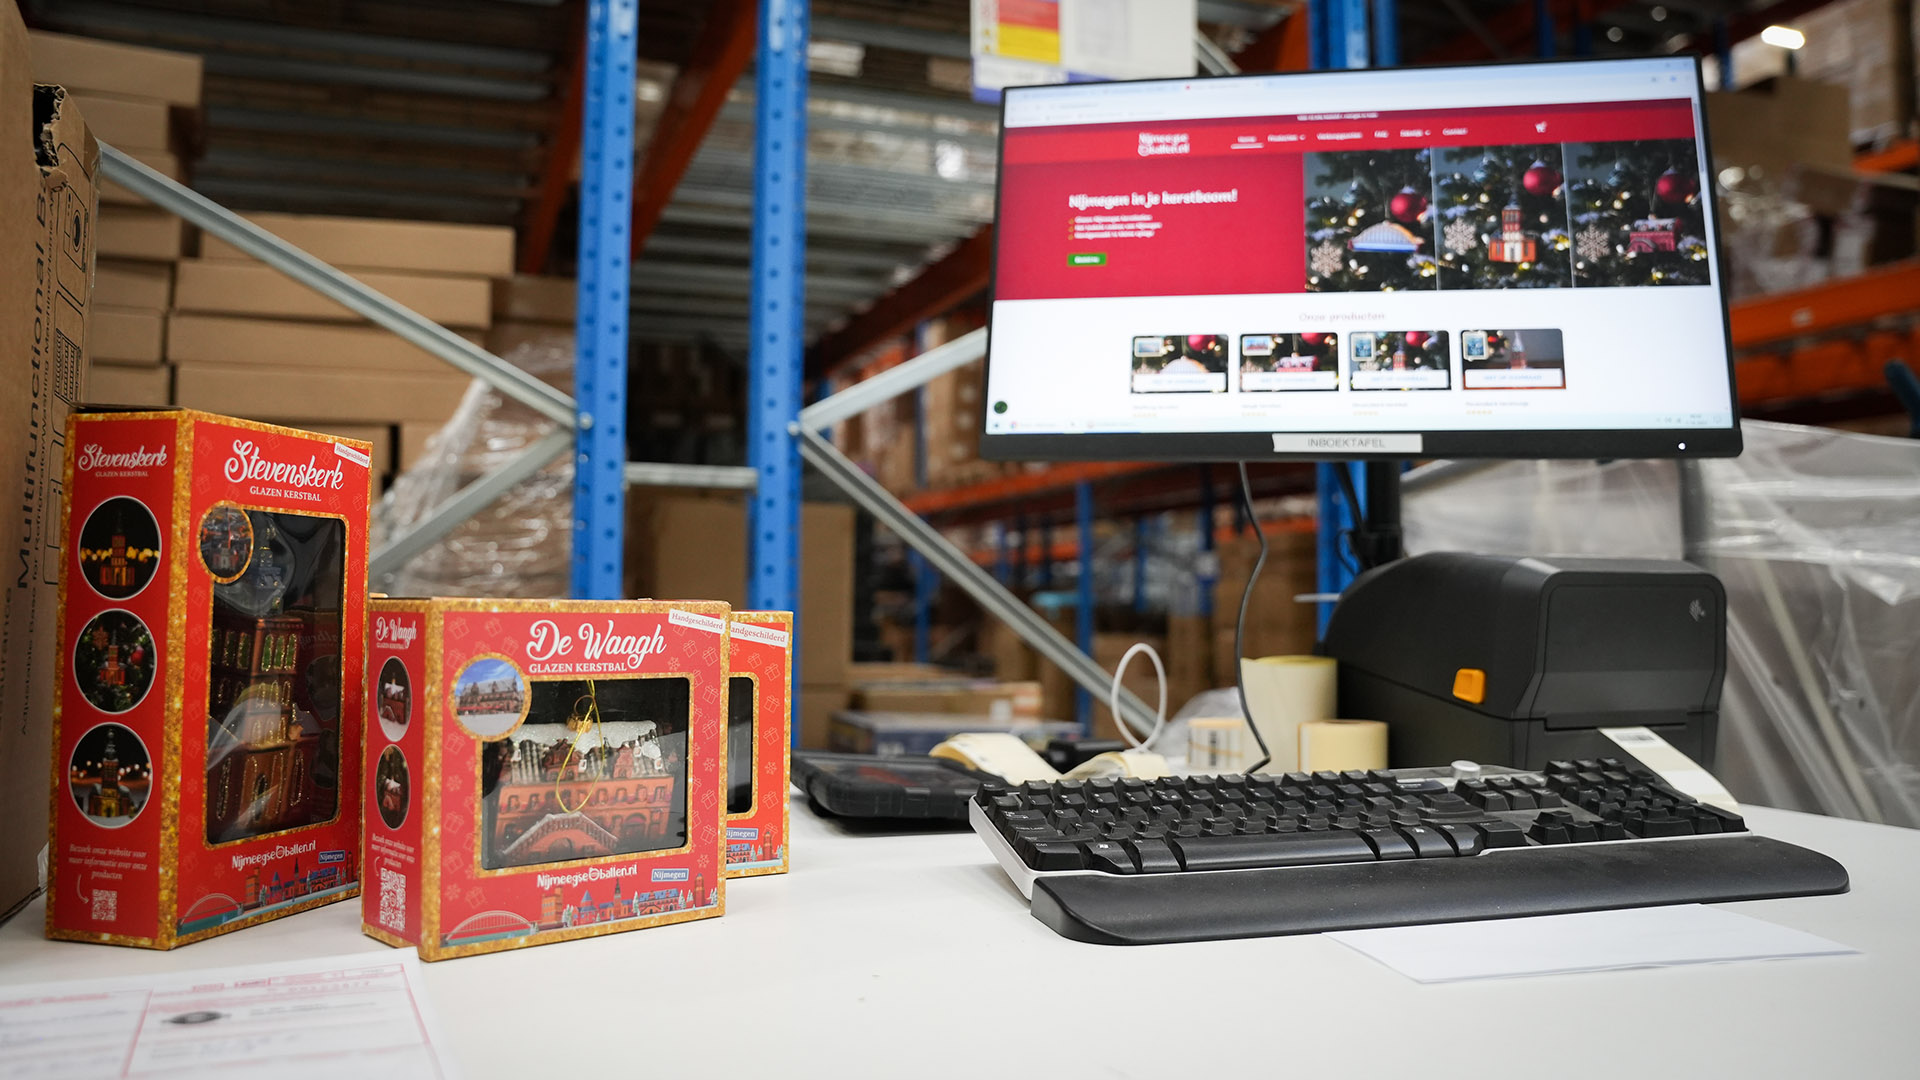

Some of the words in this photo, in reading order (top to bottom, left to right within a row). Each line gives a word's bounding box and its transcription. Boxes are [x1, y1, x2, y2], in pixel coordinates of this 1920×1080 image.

[1068, 193, 1130, 210] Nijmegen
[1131, 191, 1145, 205] in
[1145, 191, 1160, 208] je
[1161, 188, 1238, 204] kerstboom!
[1329, 311, 1385, 322] producten
[17, 241, 45, 588] Multifunctional
[1307, 437, 1385, 448] INBOEKTAFEL
[78, 443, 168, 472] Stevenskerk
[224, 439, 344, 490] Stevenskerk
[249, 486, 282, 497] GLAZEN
[283, 489, 322, 502] KERSTBAL
[671, 612, 724, 630] Handgeschilderd
[376, 616, 390, 641] De
[390, 617, 417, 649] Waagh
[731, 626, 785, 643] andgeschilderd
[526, 619, 573, 661] De
[578, 619, 667, 670] Waagh
[529, 663, 573, 674] GLAZEN
[575, 662, 627, 673] KERSTBAL
[726, 829, 755, 838] ijmegen
[320, 852, 344, 862] Nijmegen
[653, 870, 686, 880] Nijmegen
